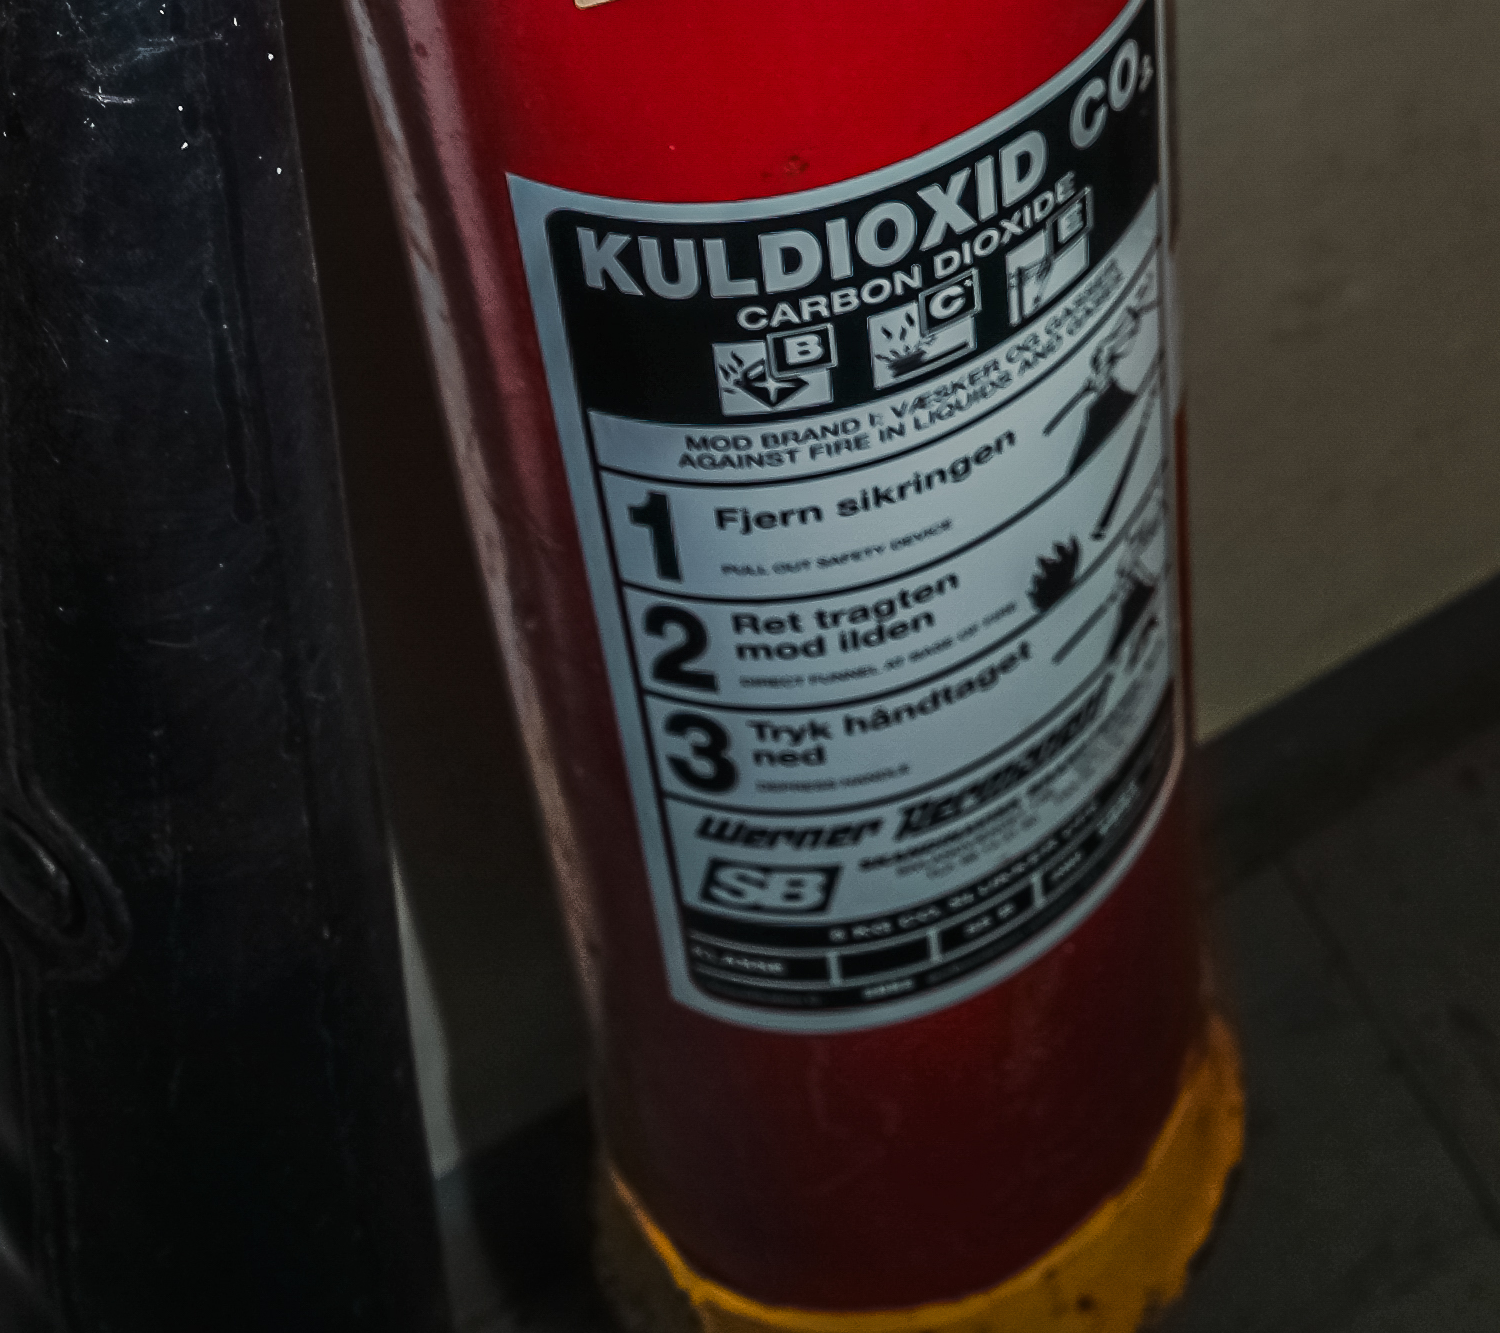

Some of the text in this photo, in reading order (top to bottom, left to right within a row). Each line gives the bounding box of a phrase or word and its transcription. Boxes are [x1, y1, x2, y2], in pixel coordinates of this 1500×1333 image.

[576, 130, 1049, 301] KULDIOXID
[736, 264, 922, 332] CARBON
[933, 172, 1078, 281] DIOXIDE
[783, 334, 823, 365] B
[678, 447, 800, 470] AGAINST
[809, 435, 871, 460] FIRE
[684, 433, 753, 453] MOD
[714, 432, 1018, 535] Fjern sikringen
[627, 489, 682, 582] 1
[731, 571, 960, 636] Ret tragten
[735, 610, 936, 662] mod ilden
[645, 603, 719, 694] 2
[747, 718, 832, 746] Tryk
[842, 641, 1033, 737] håndtaget
[664, 712, 739, 794] 3
[752, 747, 828, 766] ned
